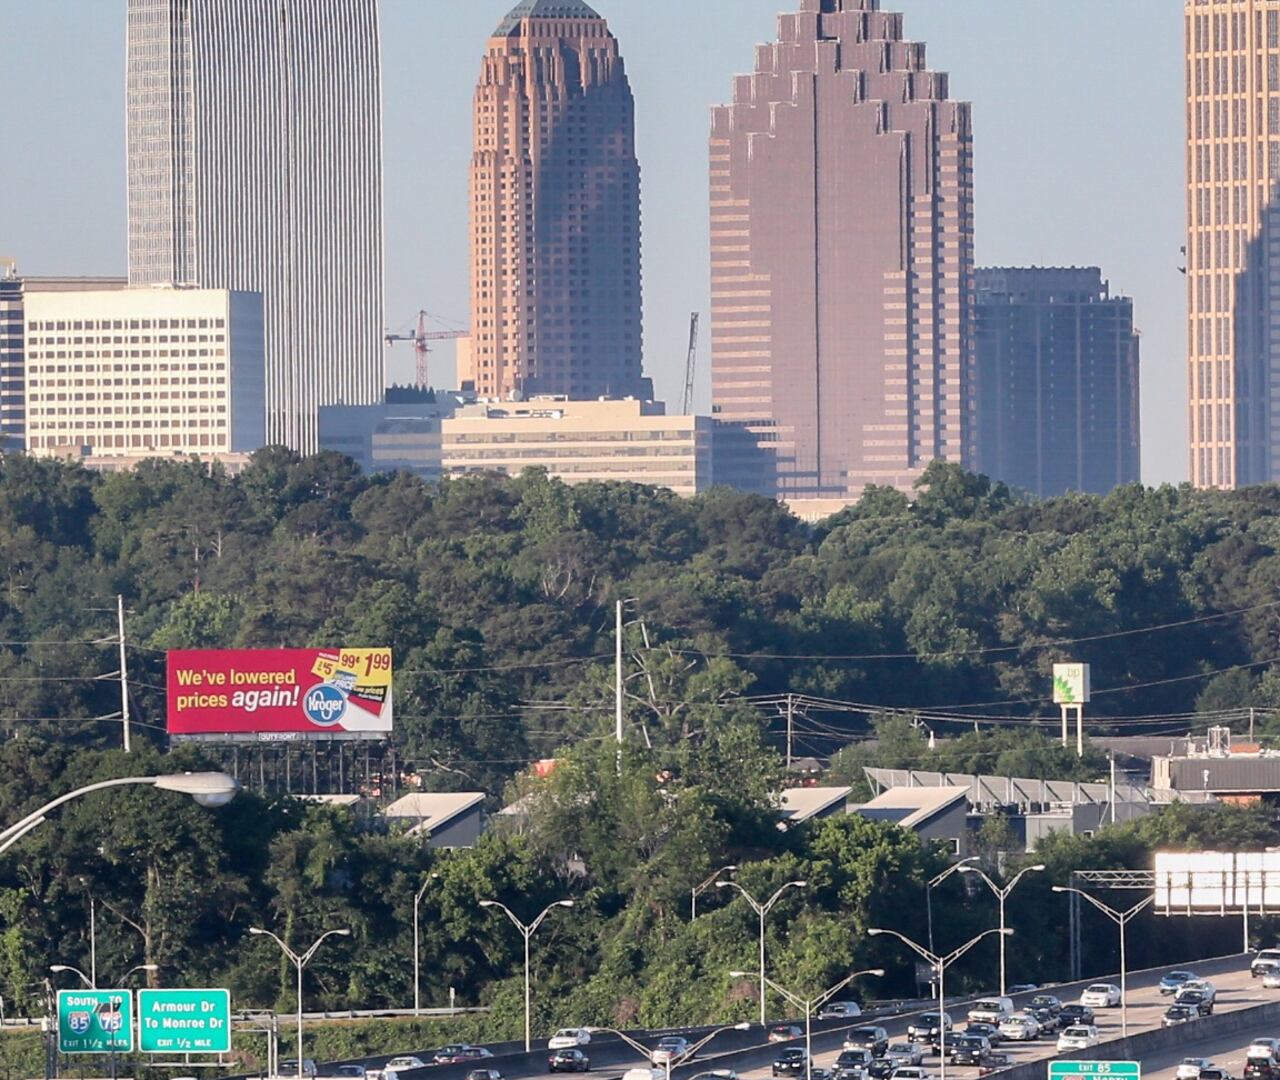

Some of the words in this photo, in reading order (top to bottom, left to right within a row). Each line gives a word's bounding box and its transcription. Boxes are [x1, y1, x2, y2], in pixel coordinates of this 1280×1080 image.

[230, 668, 296, 685] lowered
[1067, 666, 1080, 679] bp
[177, 692, 228, 712] prices
[231, 685, 300, 712] again!
[308, 690, 343, 720] Kroger
[67, 996, 98, 1006] SOUTH
[152, 1000, 196, 1013] Armour
[201, 1000, 216, 1012] Dr
[71, 1016, 89, 1030] 85
[144, 1017, 159, 1029] To
[163, 1017, 205, 1029] Monroe
[209, 1017, 224, 1029] Dr
[63, 1039, 79, 1048] EXIT
[157, 1039, 173, 1047] EXIT
[194, 1039, 212, 1047] MILE
[1078, 1063, 1094, 1072] EXIT
[1098, 1063, 1111, 1073] 85
